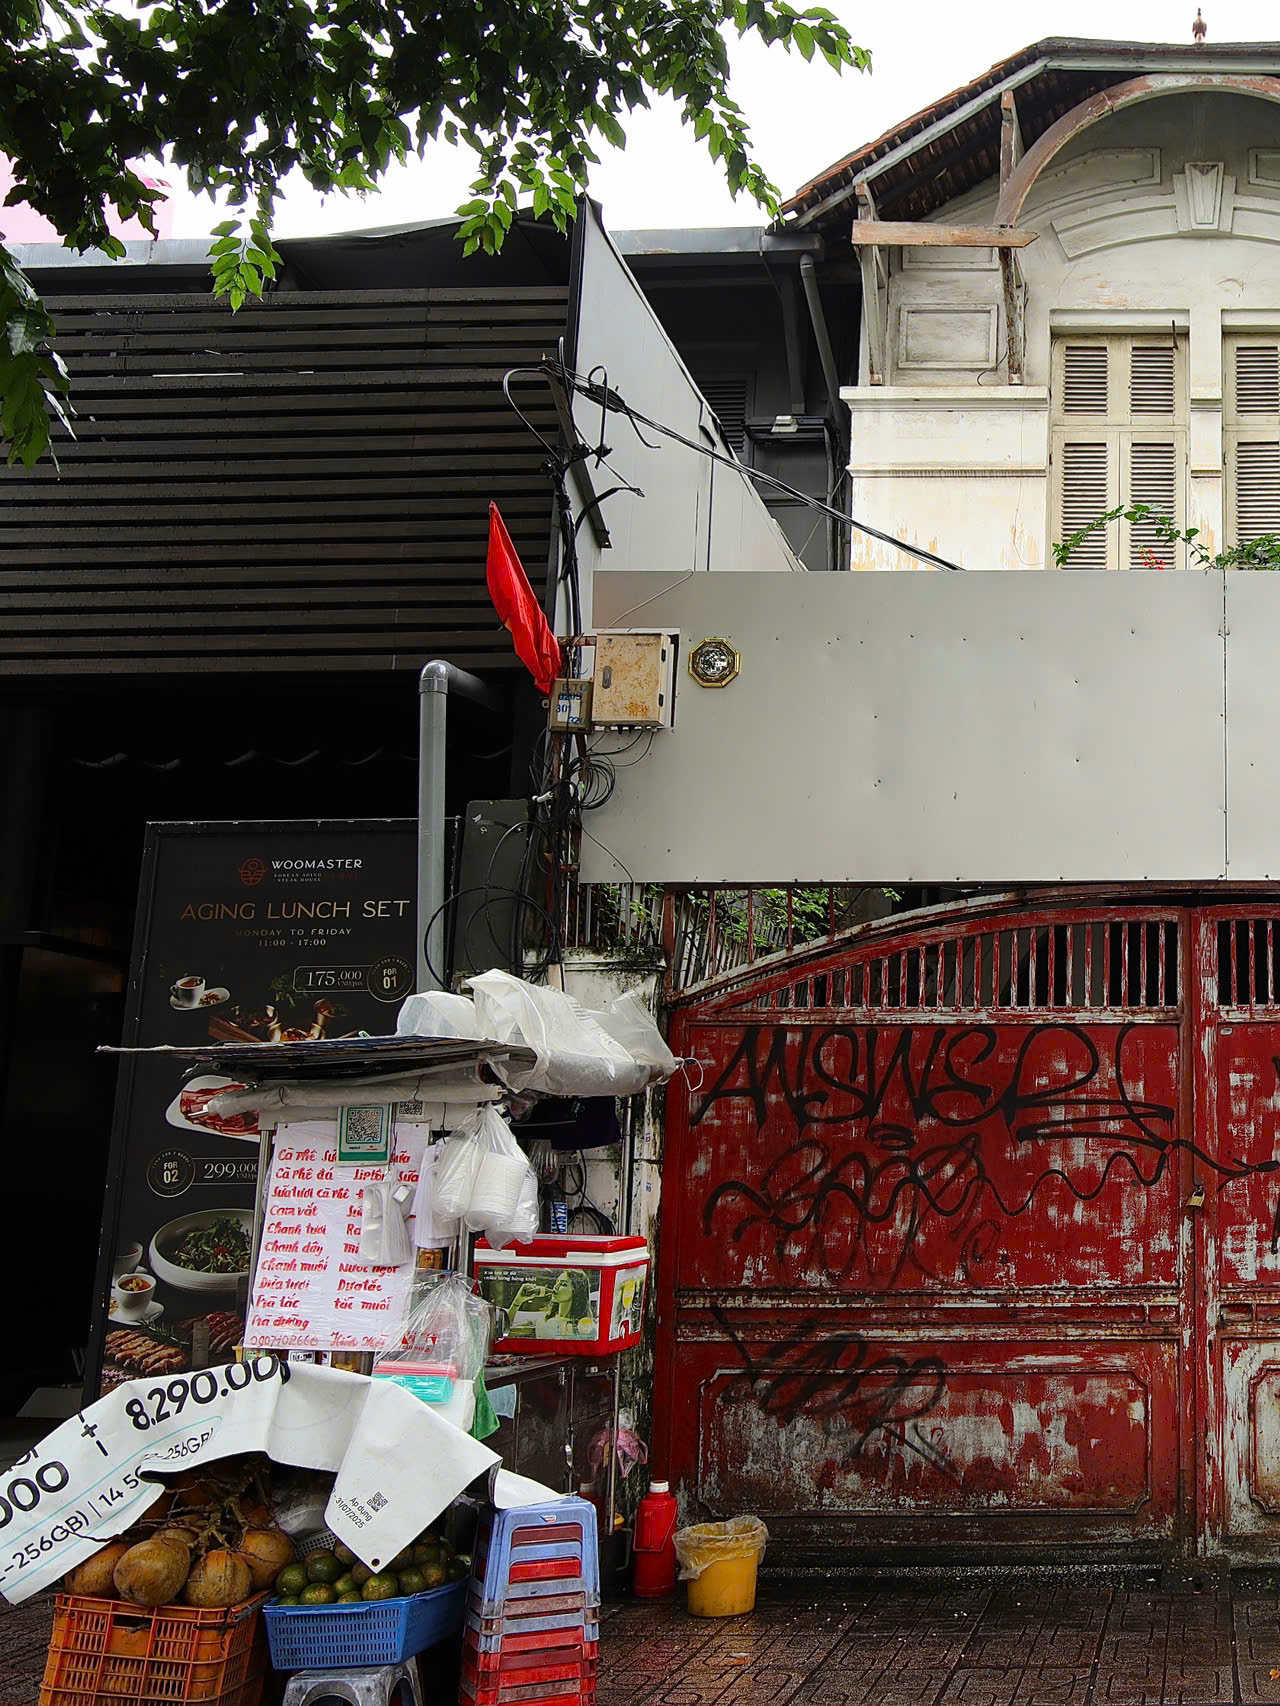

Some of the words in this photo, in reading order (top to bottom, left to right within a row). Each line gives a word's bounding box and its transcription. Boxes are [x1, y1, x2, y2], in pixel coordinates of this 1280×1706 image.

[271, 858, 363, 870] WOOMASTER
[180, 902, 256, 921] AGING
[267, 901, 352, 919] LUNCH
[362, 900, 411, 918] SET
[234, 928, 283, 937] MONDAY
[290, 928, 305, 936] TO
[311, 928, 353, 936] FRIDAY
[258, 938, 287, 947] 11:00
[297, 937, 327, 947] 17:00
[383, 967, 397, 977] FOR
[383, 976, 397, 989] 01
[163, 1161, 178, 1170] FOR
[163, 1169, 179, 1184] 02
[335, 1497, 365, 1529] 31/07/2025
